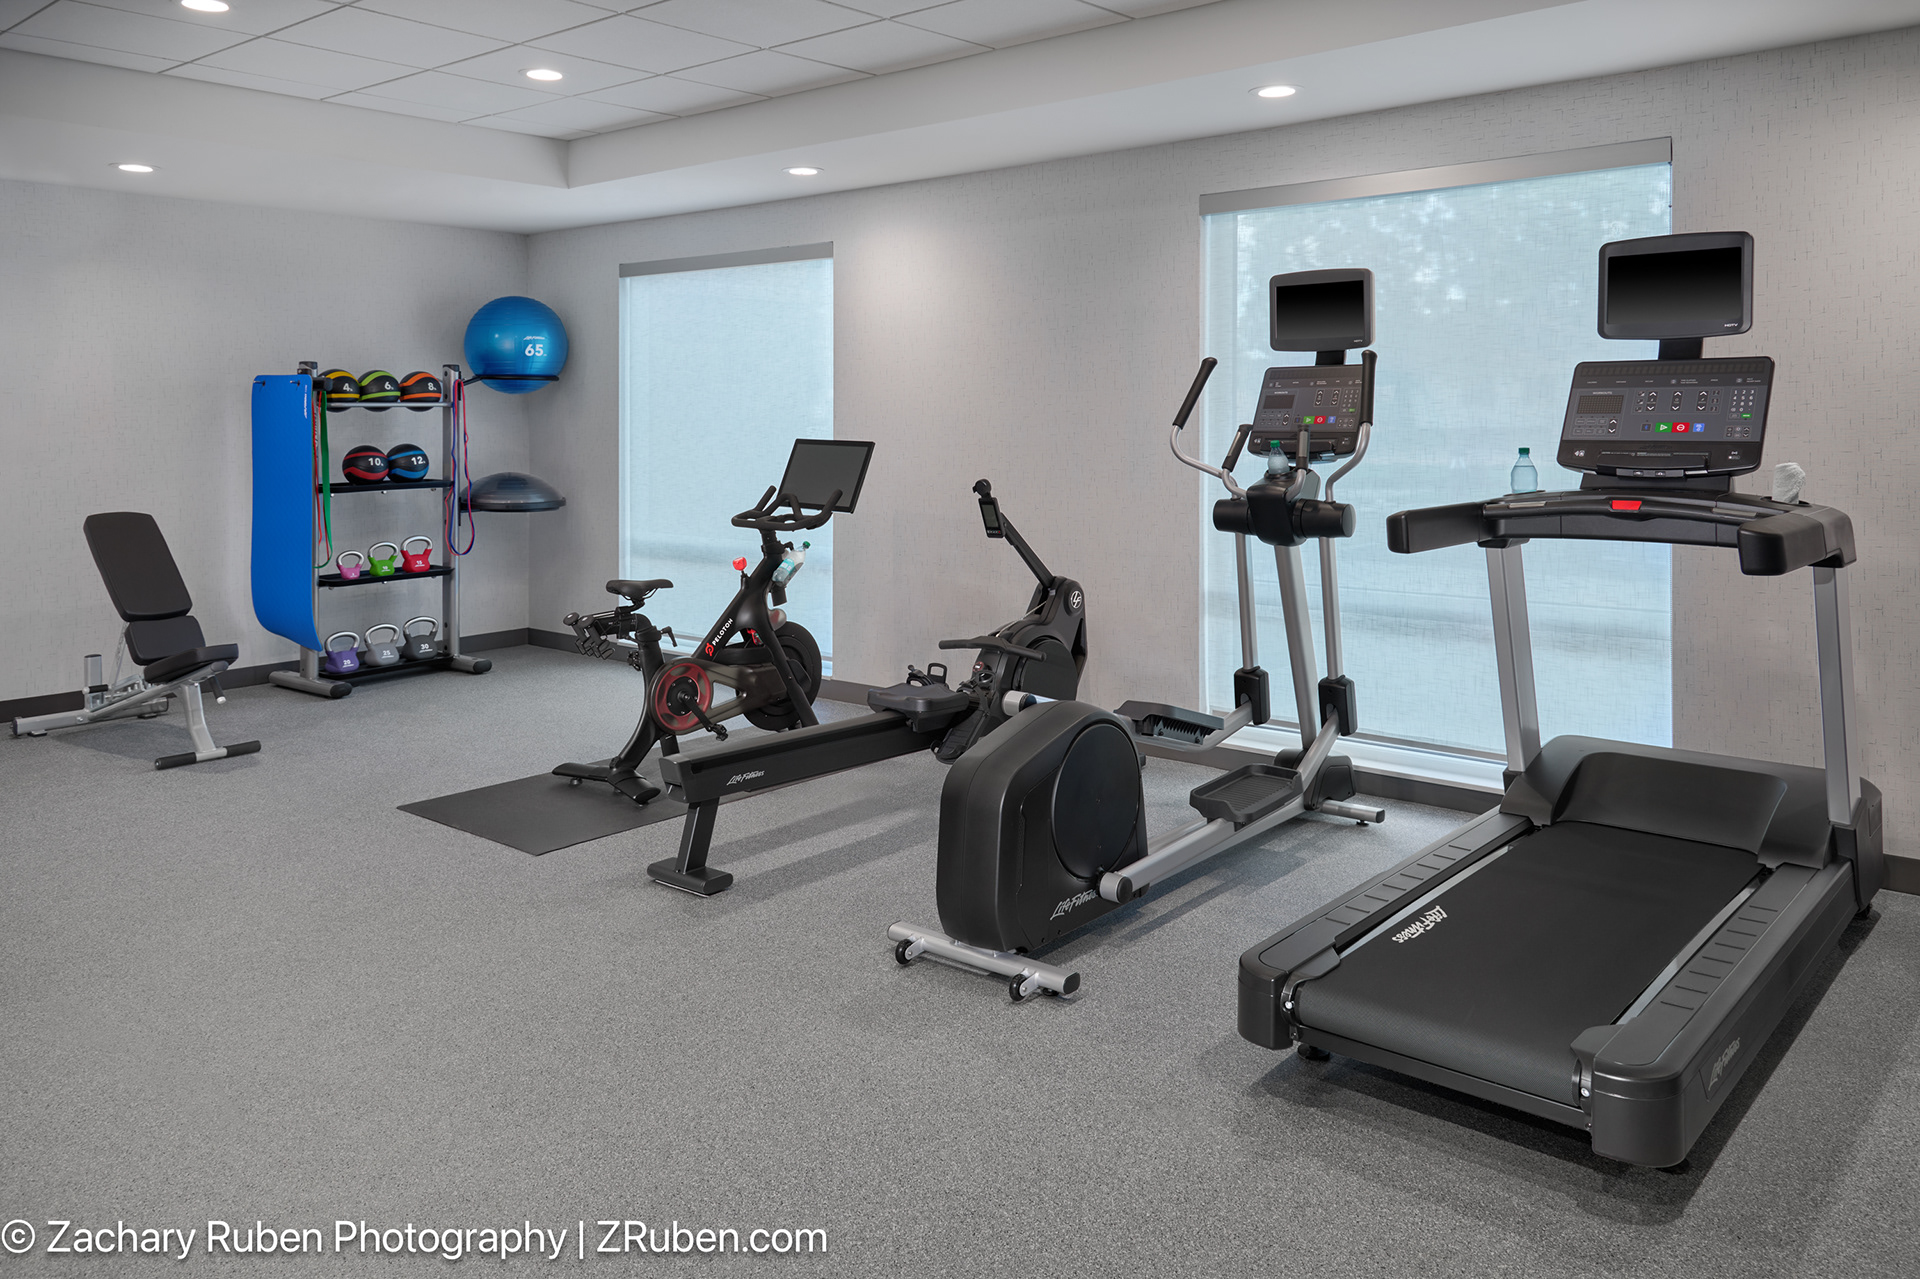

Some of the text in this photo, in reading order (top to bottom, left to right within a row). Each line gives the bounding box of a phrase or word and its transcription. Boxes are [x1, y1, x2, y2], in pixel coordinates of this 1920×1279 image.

[525, 344, 543, 356] 65
[343, 383, 350, 391] 4
[384, 382, 391, 390] 6
[427, 382, 434, 391] 8
[368, 457, 381, 466] 10
[411, 456, 424, 465] 12
[712, 618, 733, 646] PELOTON
